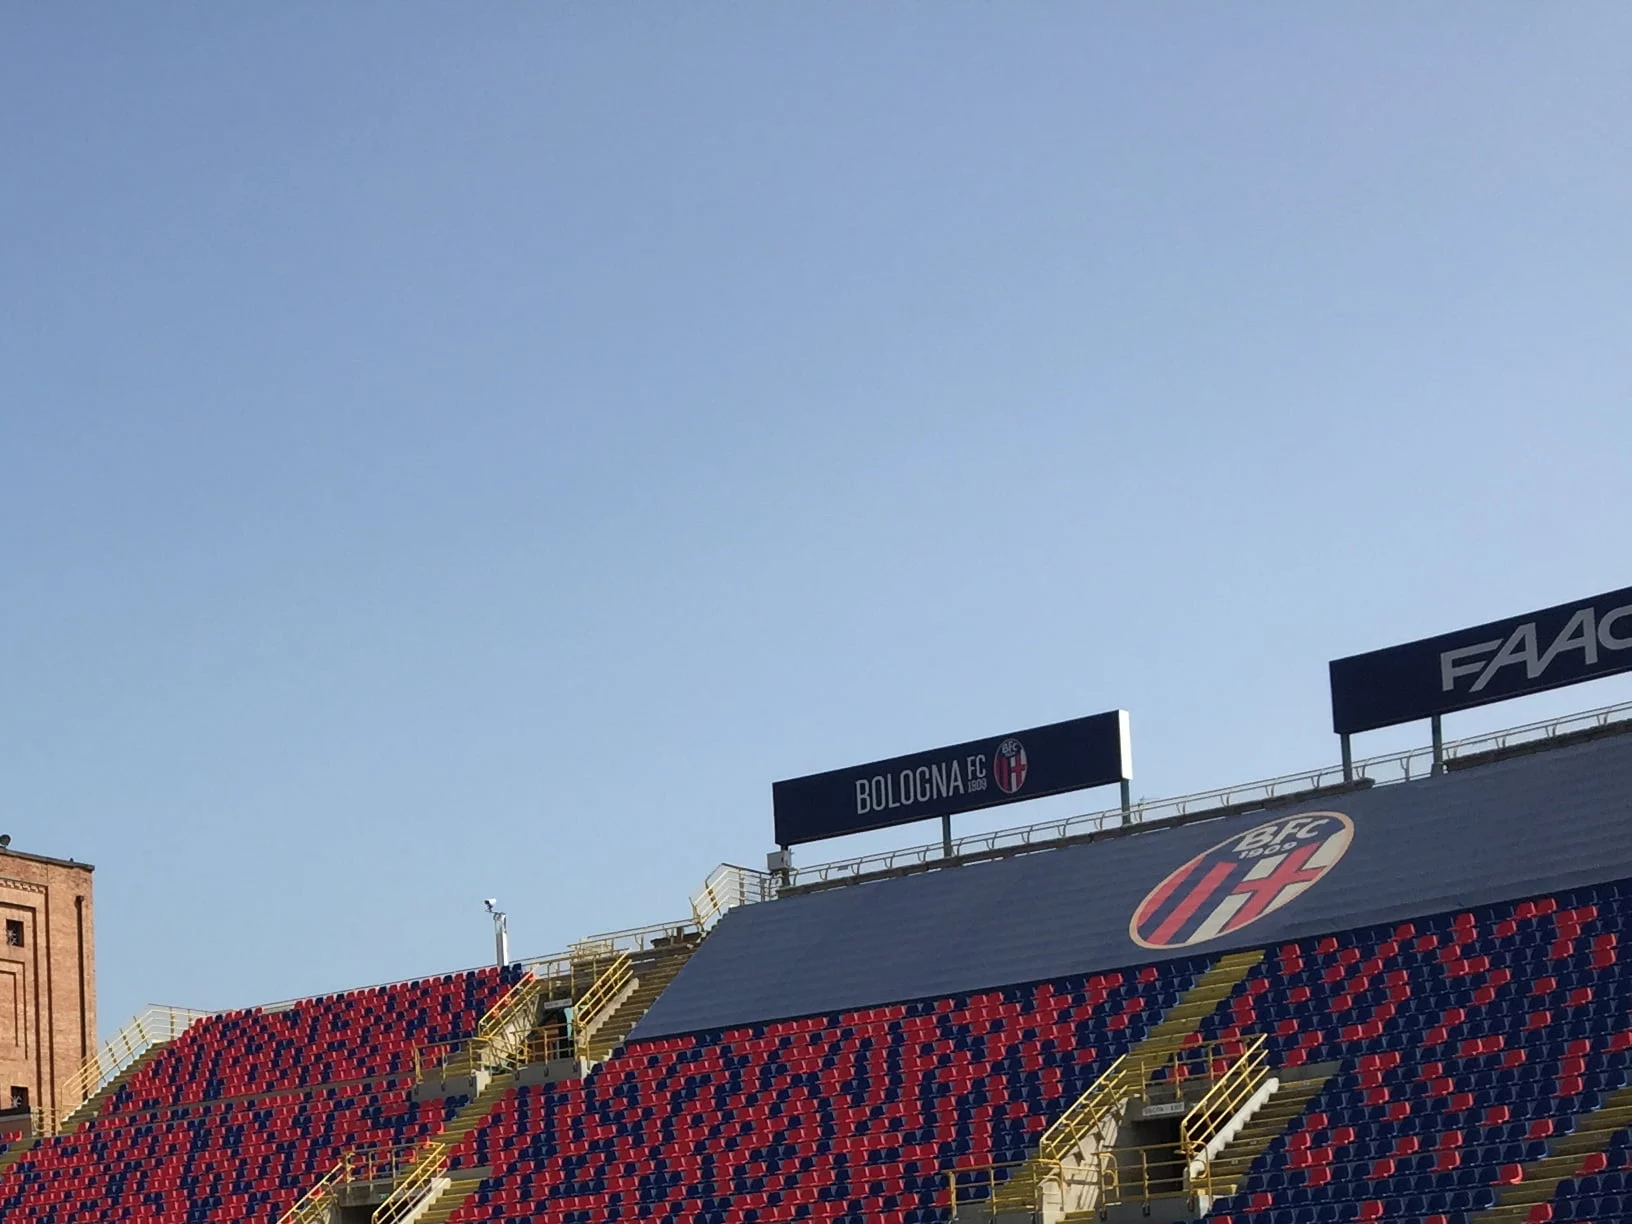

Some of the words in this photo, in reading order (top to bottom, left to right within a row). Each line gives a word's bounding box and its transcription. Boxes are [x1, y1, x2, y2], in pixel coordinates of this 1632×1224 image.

[1440, 604, 1632, 692] FAAC
[855, 760, 965, 815] BOLOGNA
[967, 754, 986, 780] FC
[1232, 818, 1329, 852] BFC
[1238, 841, 1298, 859] 1909
